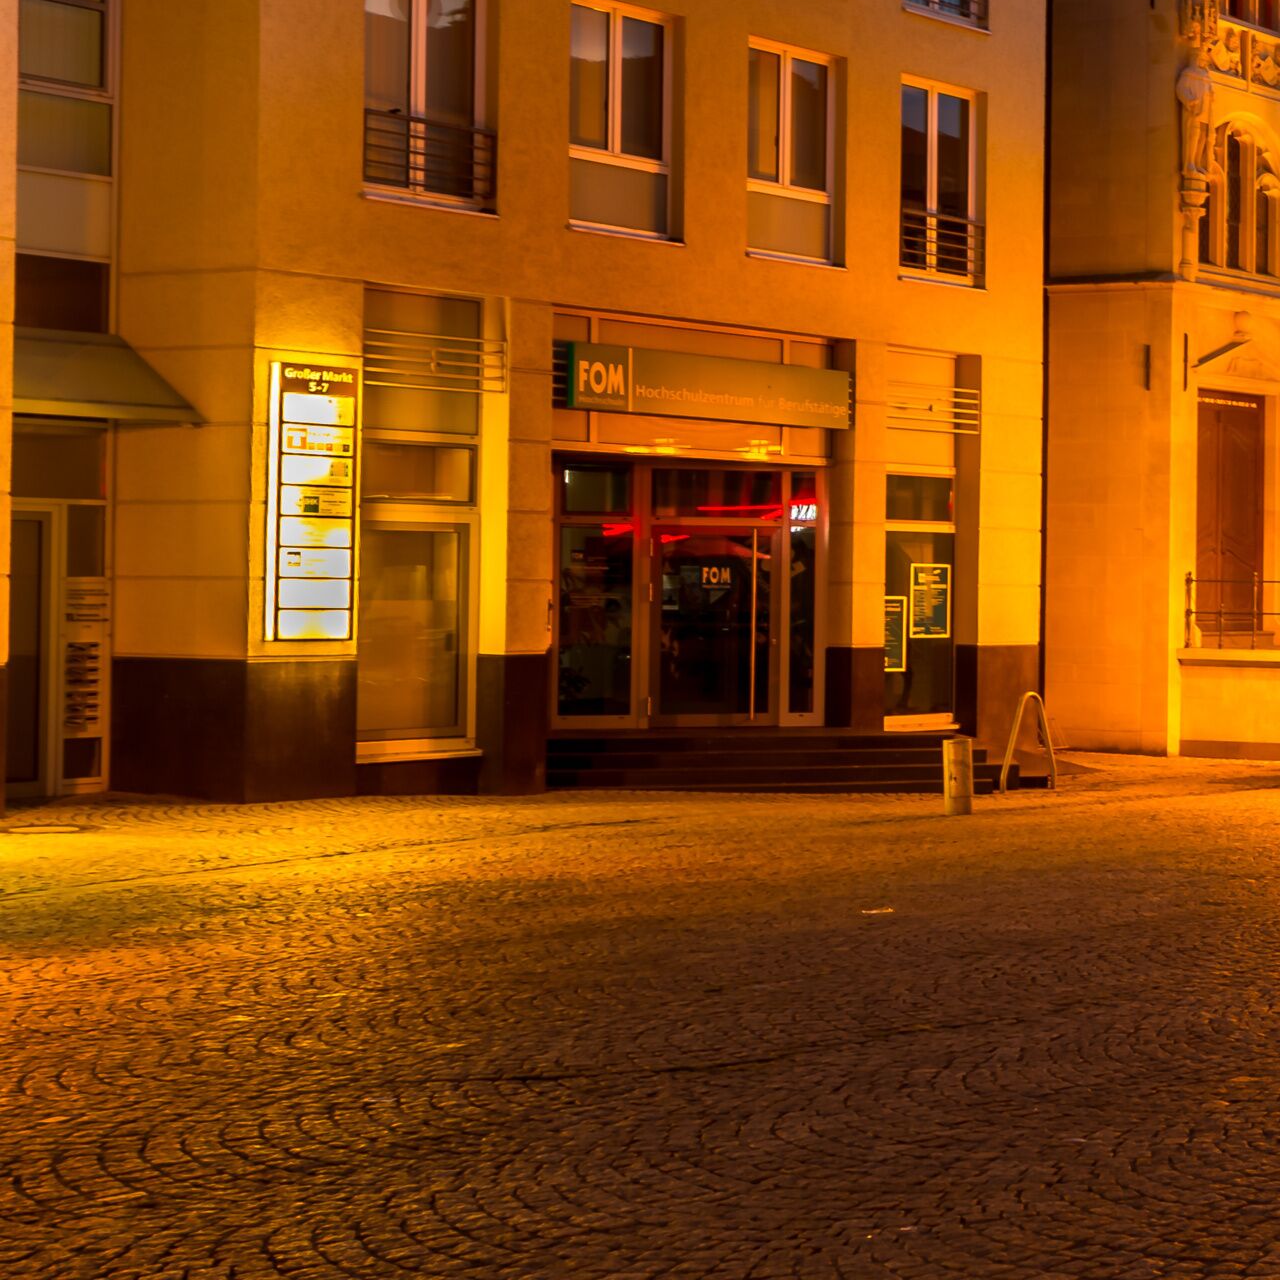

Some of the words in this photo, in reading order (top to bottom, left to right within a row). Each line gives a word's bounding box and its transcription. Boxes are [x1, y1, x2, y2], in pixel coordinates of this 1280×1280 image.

[285, 368, 321, 380] Großer
[322, 371, 353, 383] Markt
[579, 360, 624, 395] FOM
[308, 382, 329, 392] 5-7
[636, 384, 754, 407] Hochschulzentrum
[778, 397, 847, 418] Berufstätige
[702, 567, 731, 583] FOM
